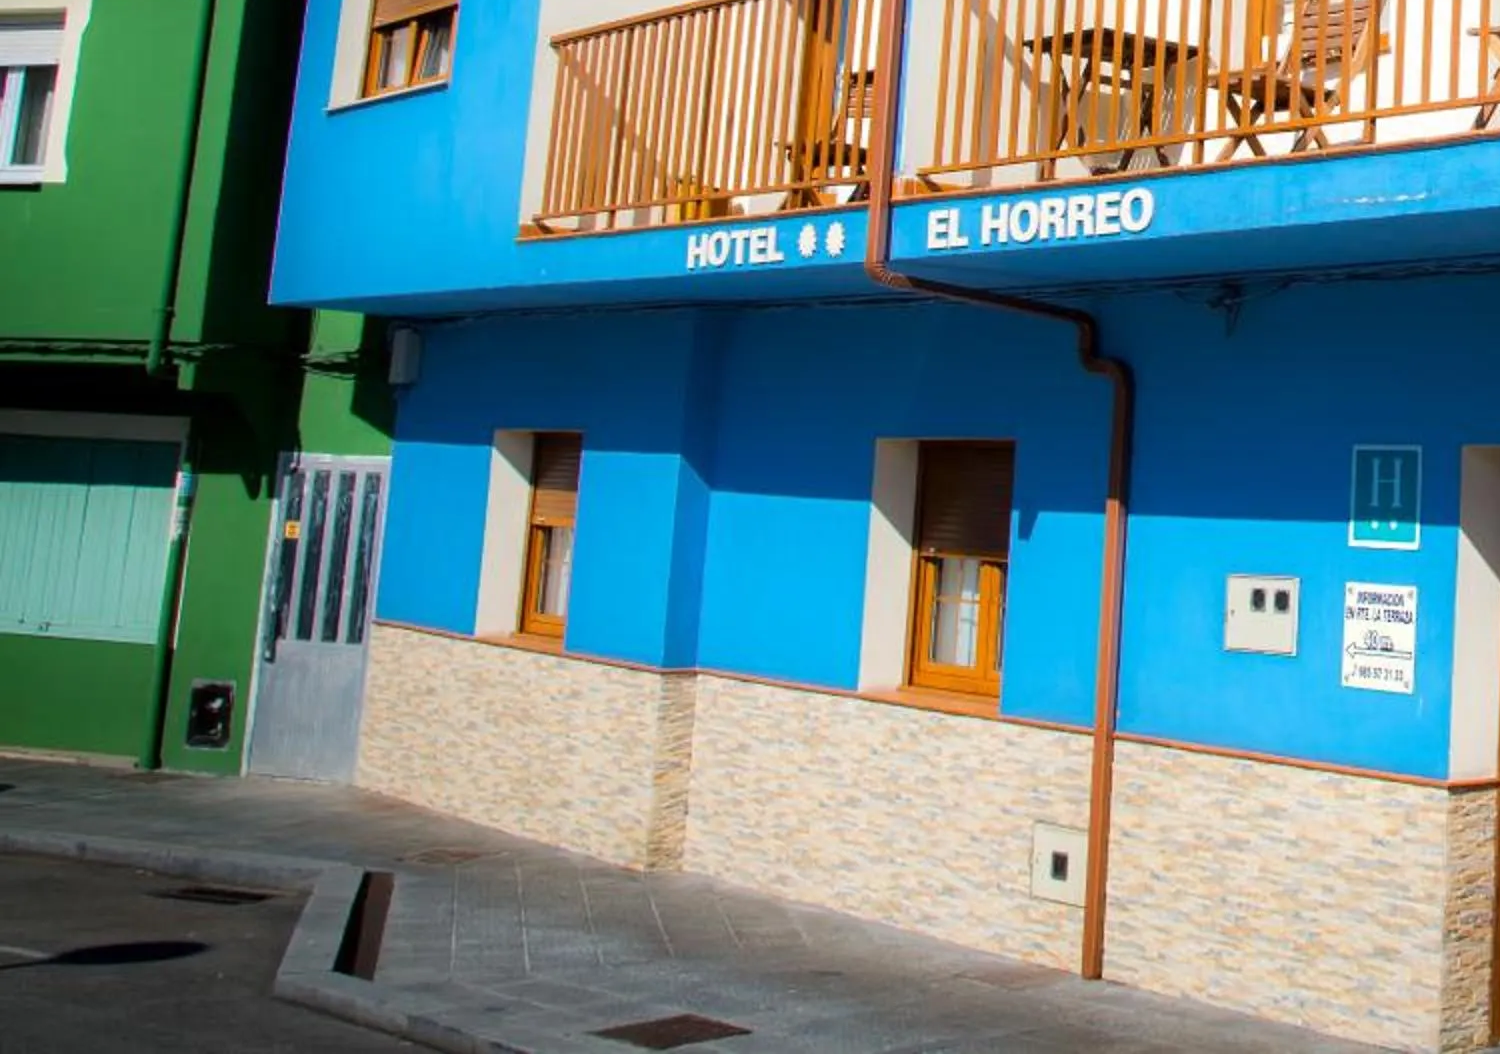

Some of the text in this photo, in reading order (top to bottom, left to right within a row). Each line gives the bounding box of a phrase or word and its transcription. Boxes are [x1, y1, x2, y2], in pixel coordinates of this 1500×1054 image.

[926, 187, 1155, 250] EL HORREO
[686, 226, 784, 270] HOTEL
[1368, 457, 1404, 508] H
